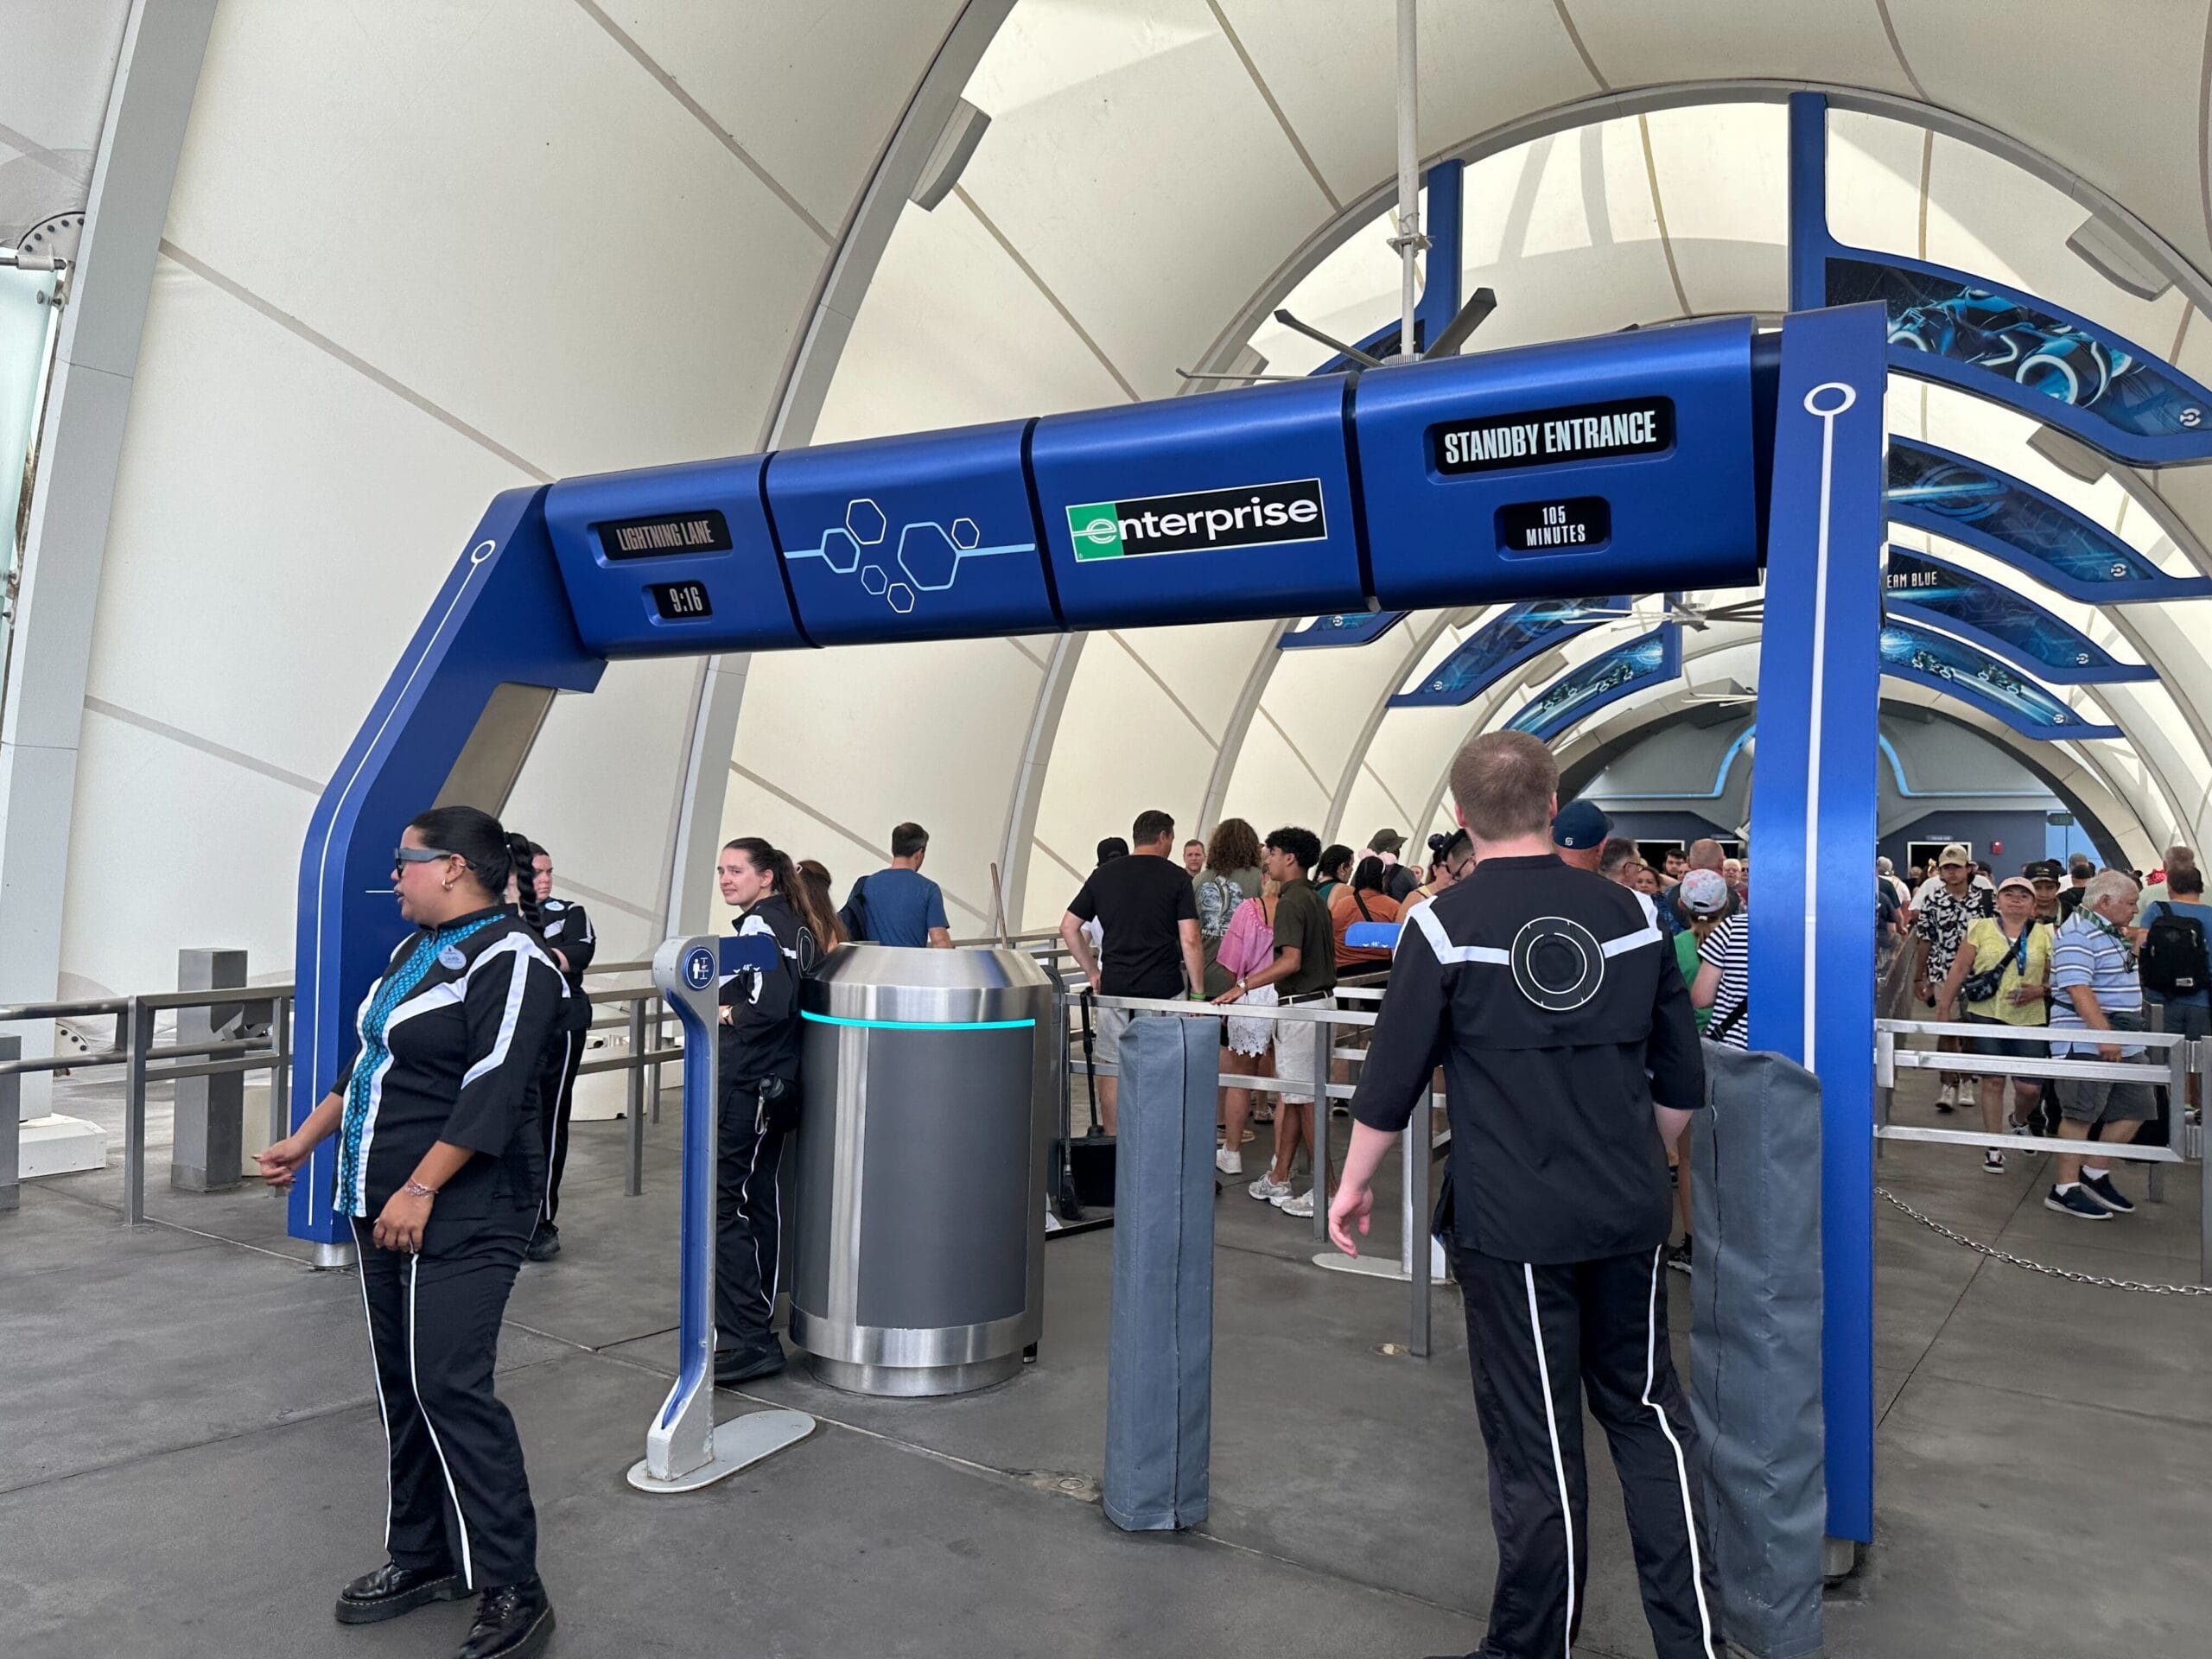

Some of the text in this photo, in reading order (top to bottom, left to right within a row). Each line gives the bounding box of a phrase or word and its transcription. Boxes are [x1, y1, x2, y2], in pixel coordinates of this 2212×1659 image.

[1445, 410, 1657, 464] STANDBY ENTRANCE
[1074, 496, 1319, 545] enterprise
[1541, 505, 1567, 525] 105
[616, 520, 715, 551] LIGHTNING LANE
[1526, 524, 1586, 547] MINUTES
[1886, 571, 1938, 588] EAM BLUE
[669, 586, 703, 613] 9:16
